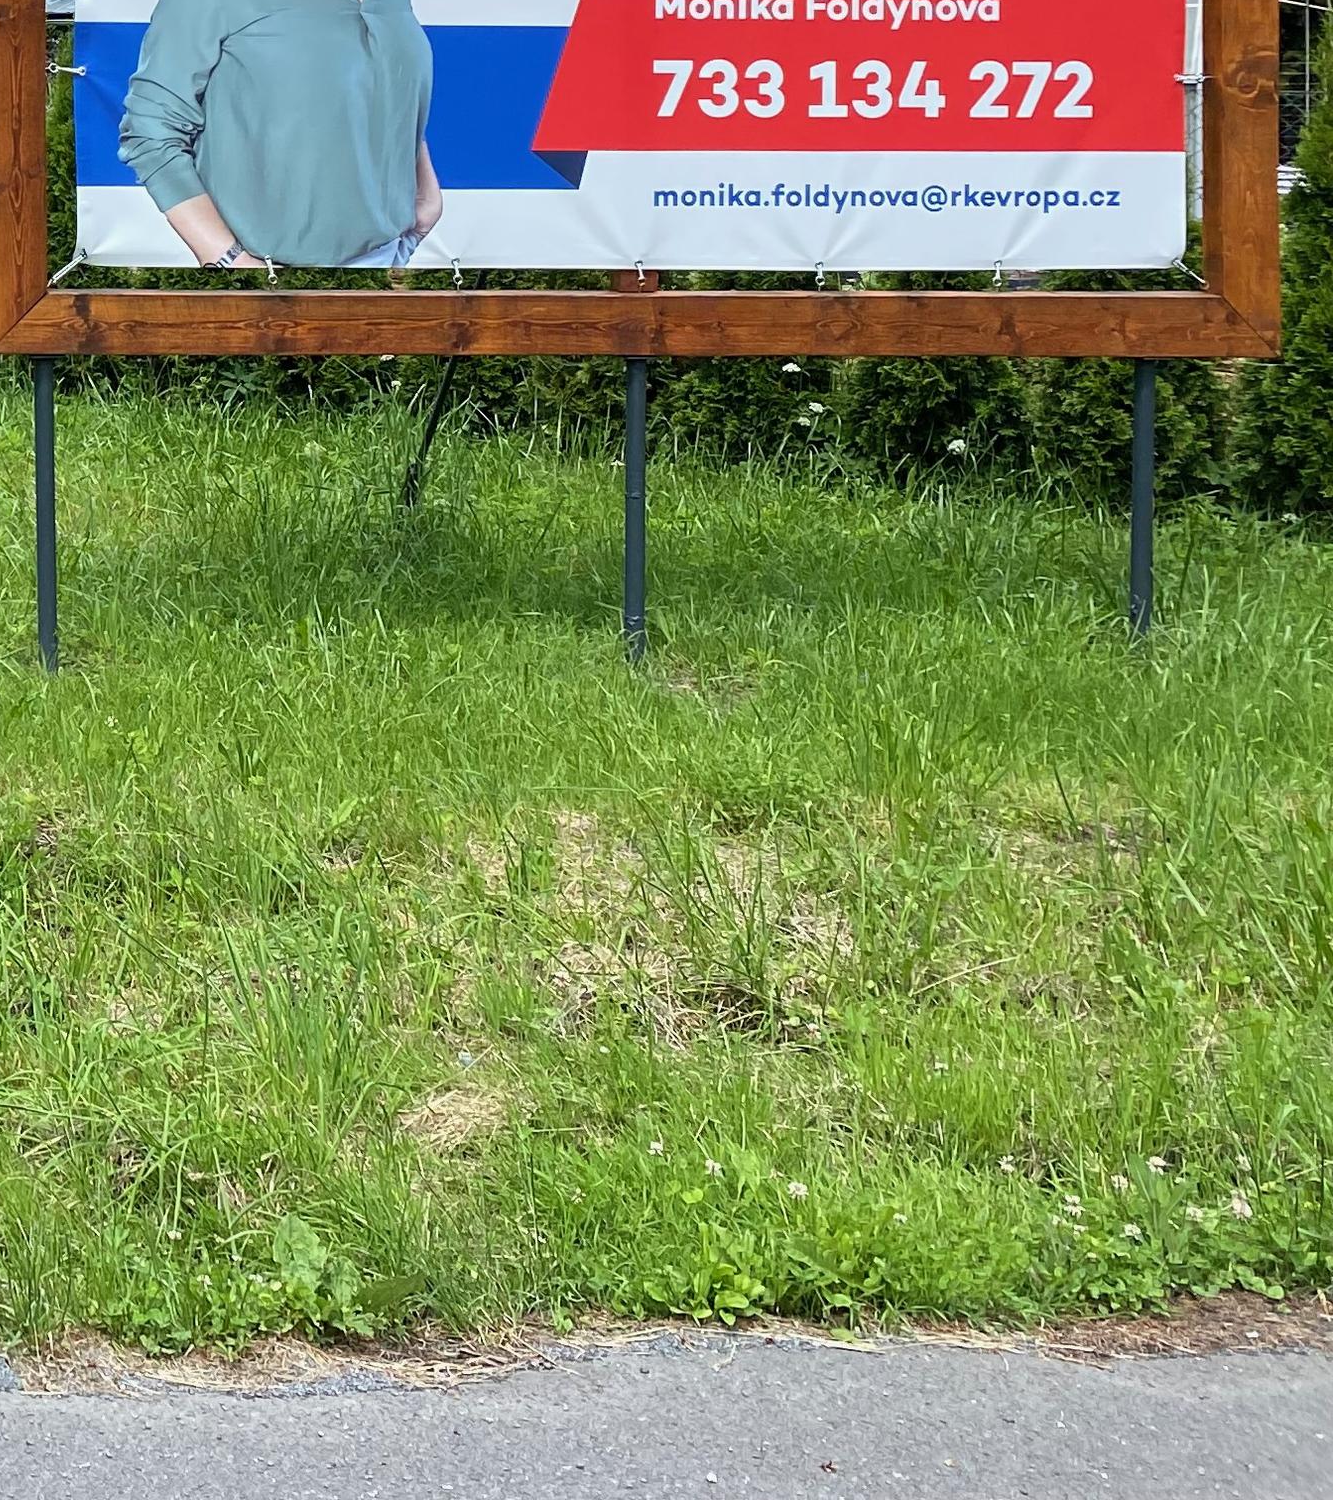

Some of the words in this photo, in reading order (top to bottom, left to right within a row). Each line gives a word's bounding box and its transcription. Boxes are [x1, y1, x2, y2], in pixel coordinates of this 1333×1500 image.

[652, 58, 786, 119] 733
[807, 60, 946, 119] 134
[968, 60, 1094, 119] 272
[651, 182, 1122, 214] monika.foldynova@rkevropa.cz
